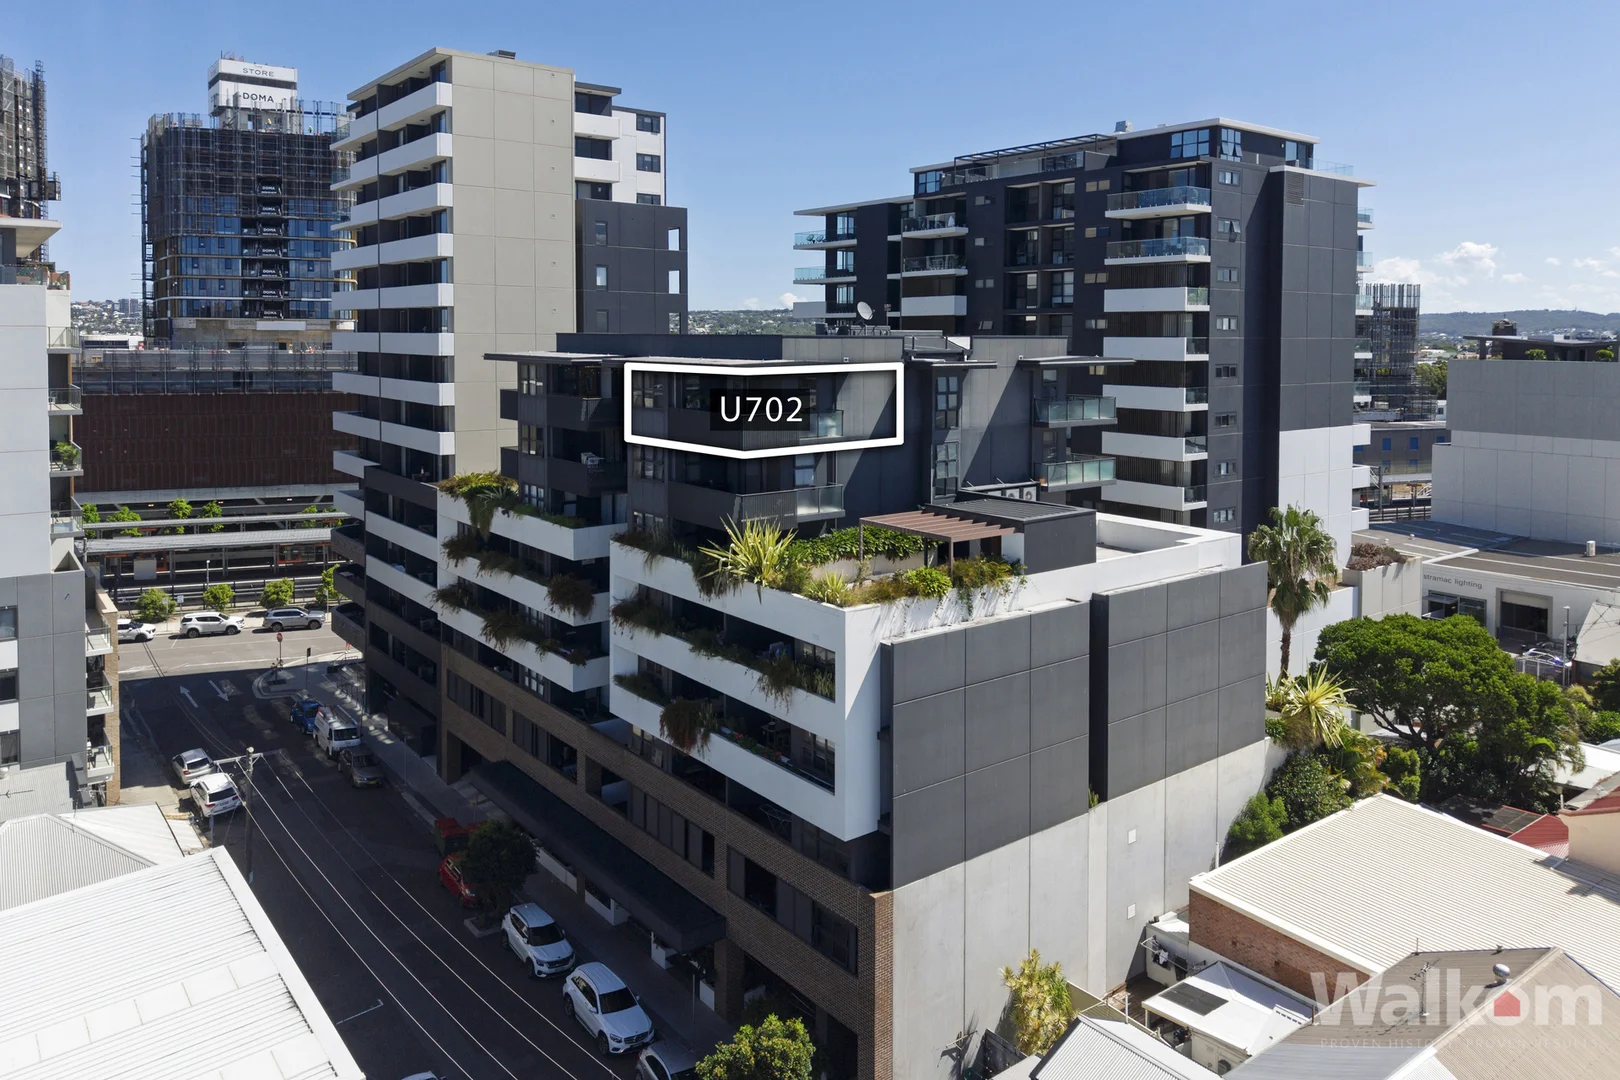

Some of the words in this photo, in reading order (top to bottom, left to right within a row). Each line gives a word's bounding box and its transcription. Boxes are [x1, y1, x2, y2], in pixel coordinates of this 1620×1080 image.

[242, 67, 275, 77] STORE
[242, 92, 274, 103] DOMA
[1454, 578, 1483, 590] lighting
